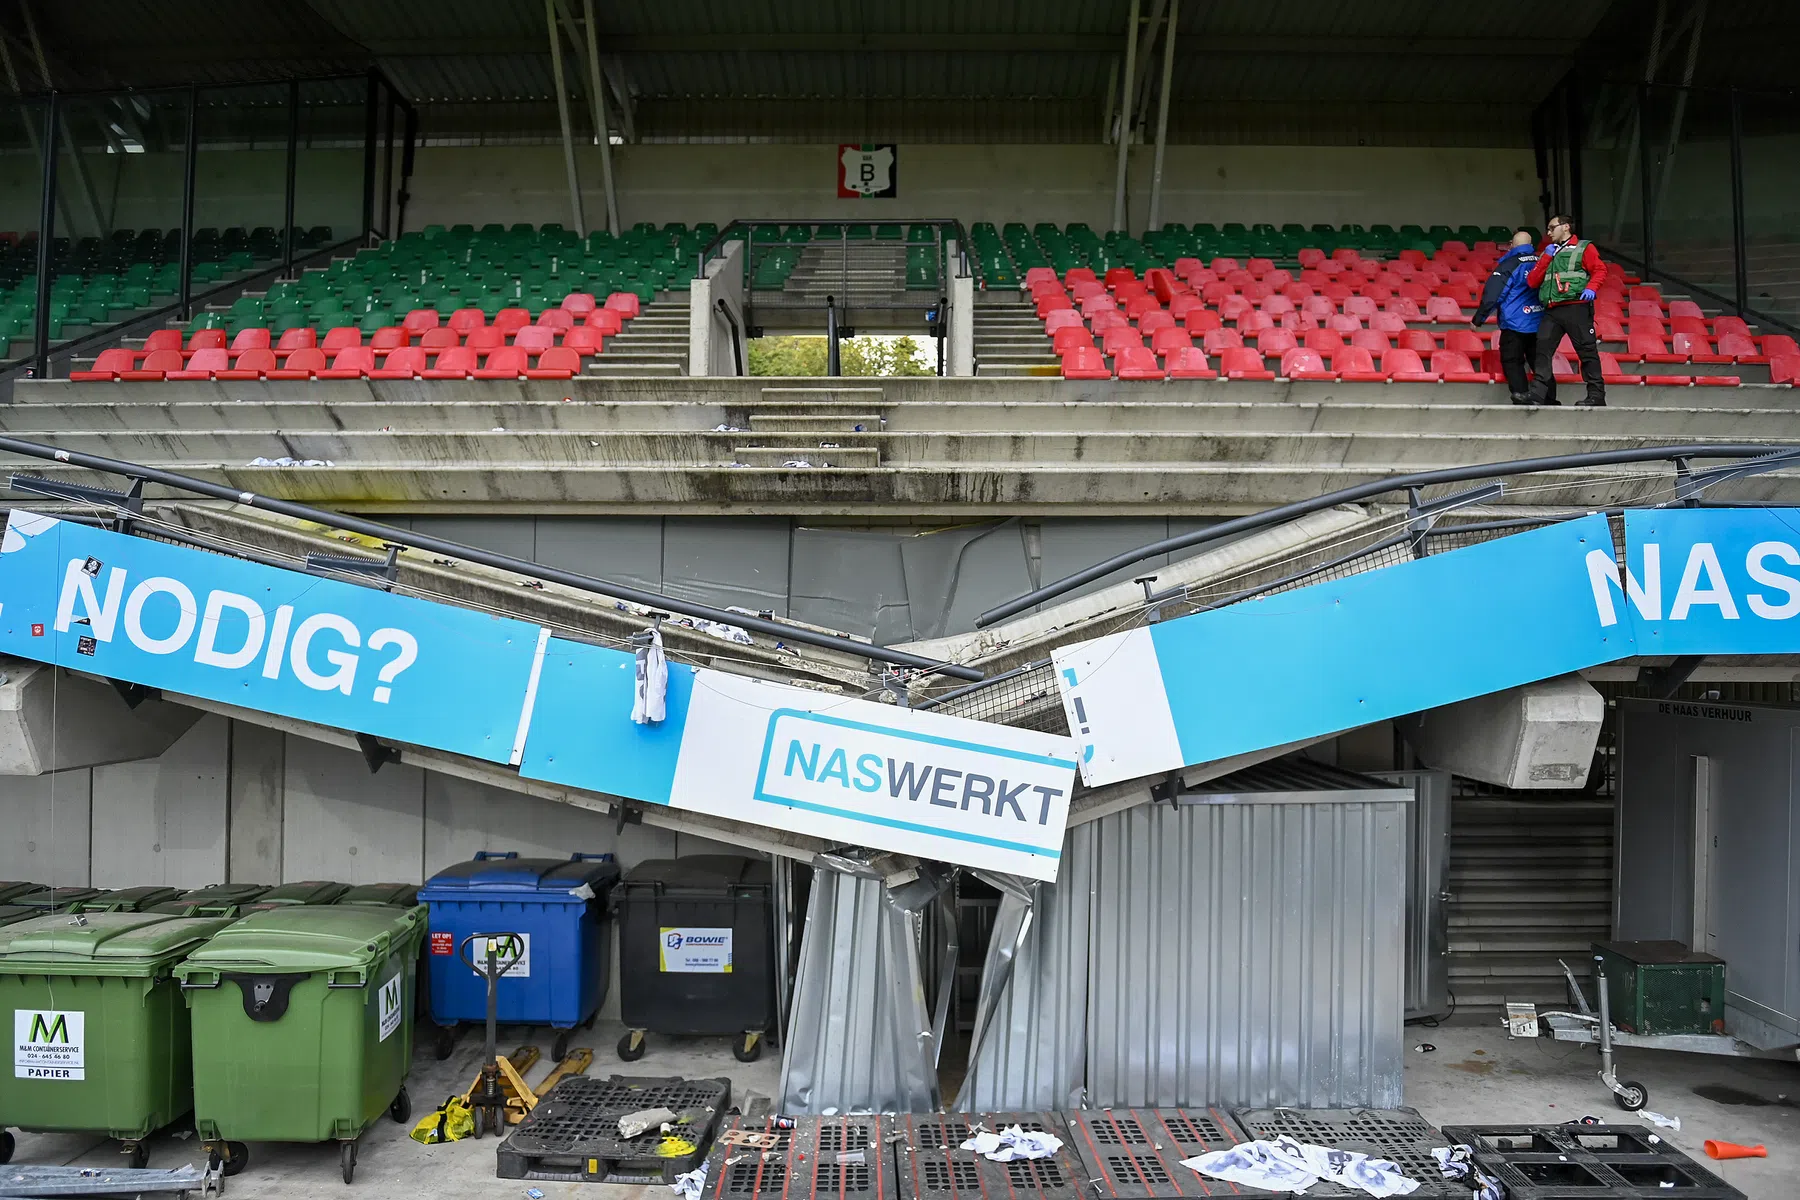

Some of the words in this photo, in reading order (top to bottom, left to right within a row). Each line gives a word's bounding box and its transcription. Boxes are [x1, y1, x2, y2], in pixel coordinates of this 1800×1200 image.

[860, 163, 875, 182] B
[1585, 541, 1800, 627] NAS
[54, 558, 418, 704] NODIG?
[1658, 703, 1671, 714] DE
[1673, 704, 1699, 717] HAAS
[1701, 706, 1752, 722] VERHUUR
[784, 739, 1063, 826] NASWERKT
[28, 1013, 69, 1043] M
[28, 1068, 70, 1078] PAPIER
